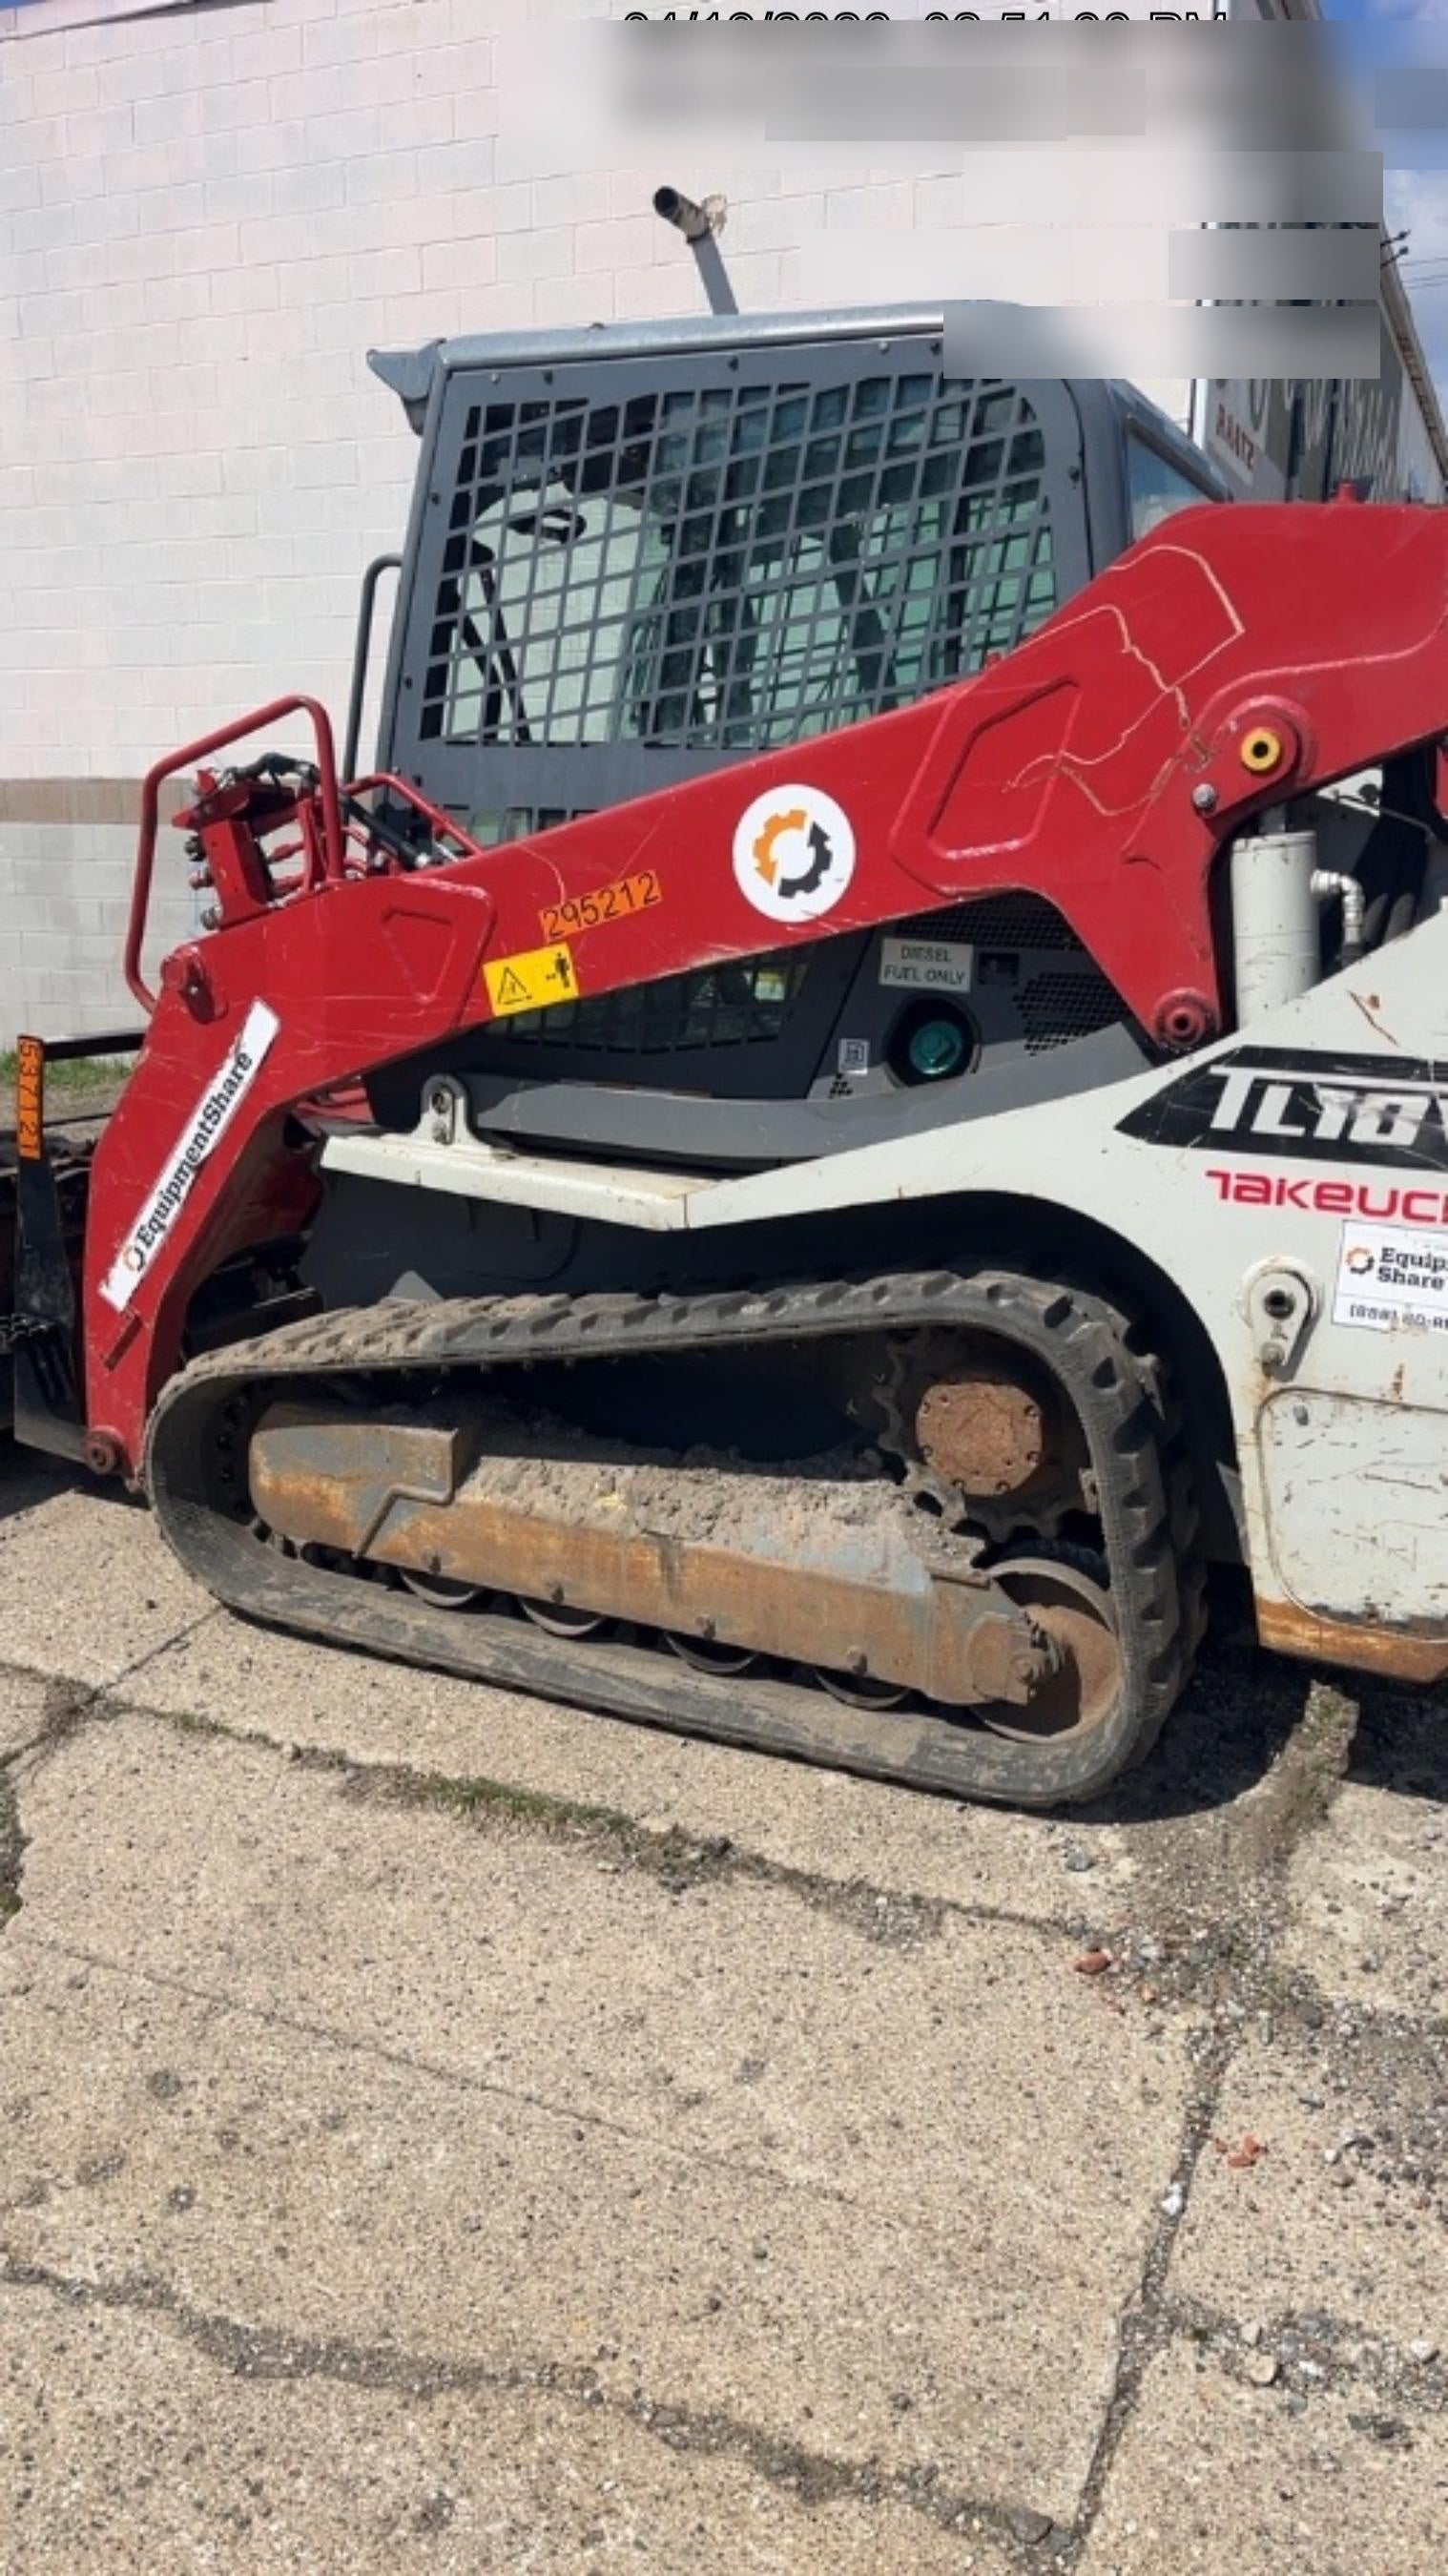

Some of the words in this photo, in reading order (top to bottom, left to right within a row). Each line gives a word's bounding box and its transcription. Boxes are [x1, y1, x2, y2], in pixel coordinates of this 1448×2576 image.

[543, 872, 660, 938] 295212
[900, 944, 952, 963] DIESEL
[884, 964, 921, 982] FUEL
[924, 967, 965, 986] ONLY
[136, 1051, 253, 1249] EquipmentShare
[1379, 1246, 1448, 1275] Equip
[1377, 1267, 1444, 1291] Share
